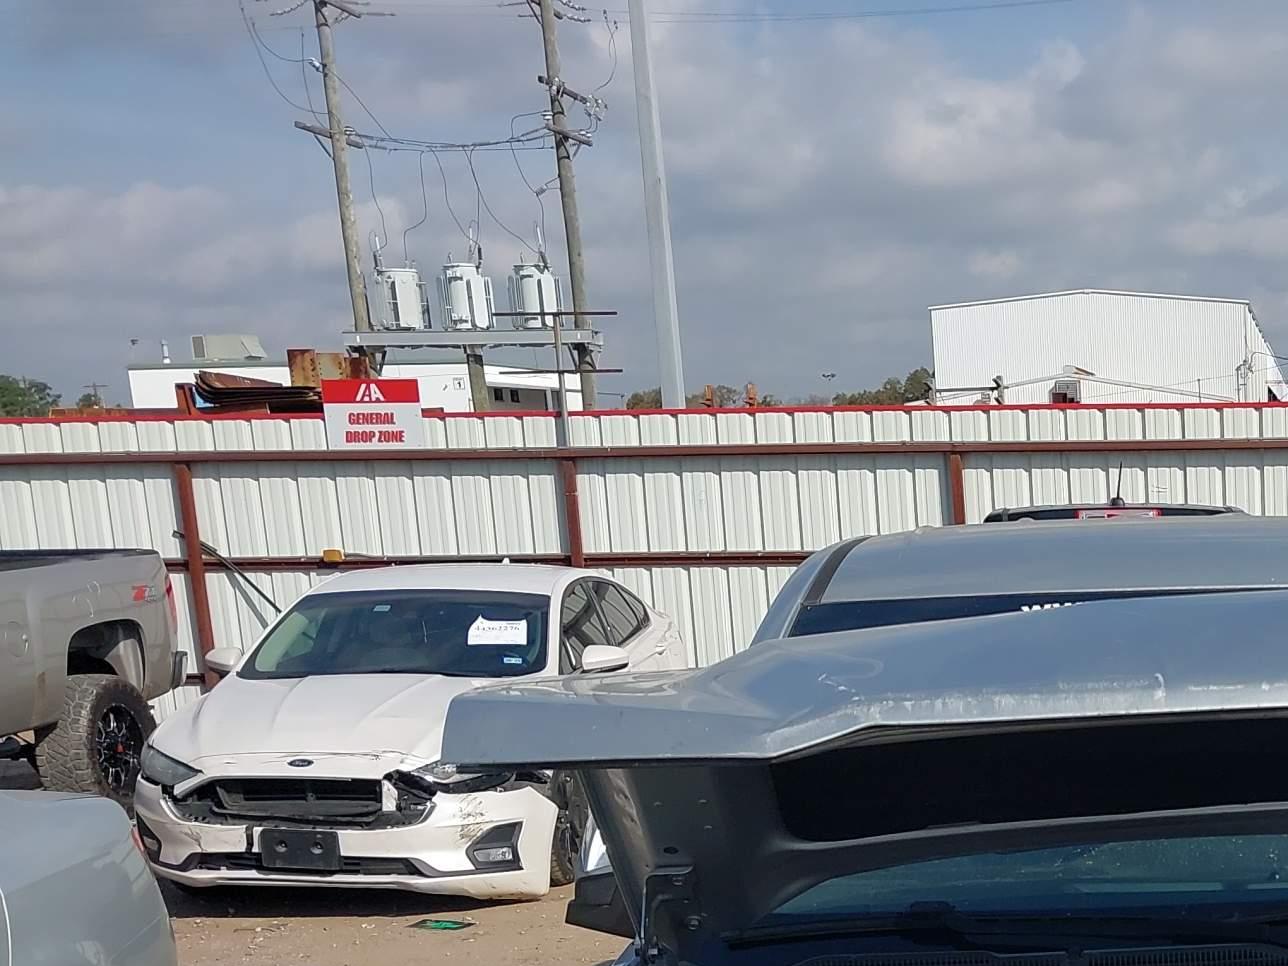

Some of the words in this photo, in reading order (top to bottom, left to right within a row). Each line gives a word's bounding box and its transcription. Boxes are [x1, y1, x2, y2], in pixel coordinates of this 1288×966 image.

[348, 412, 395, 425] GENERAL
[345, 430, 376, 443] DROP
[378, 430, 405, 443] ZONE
